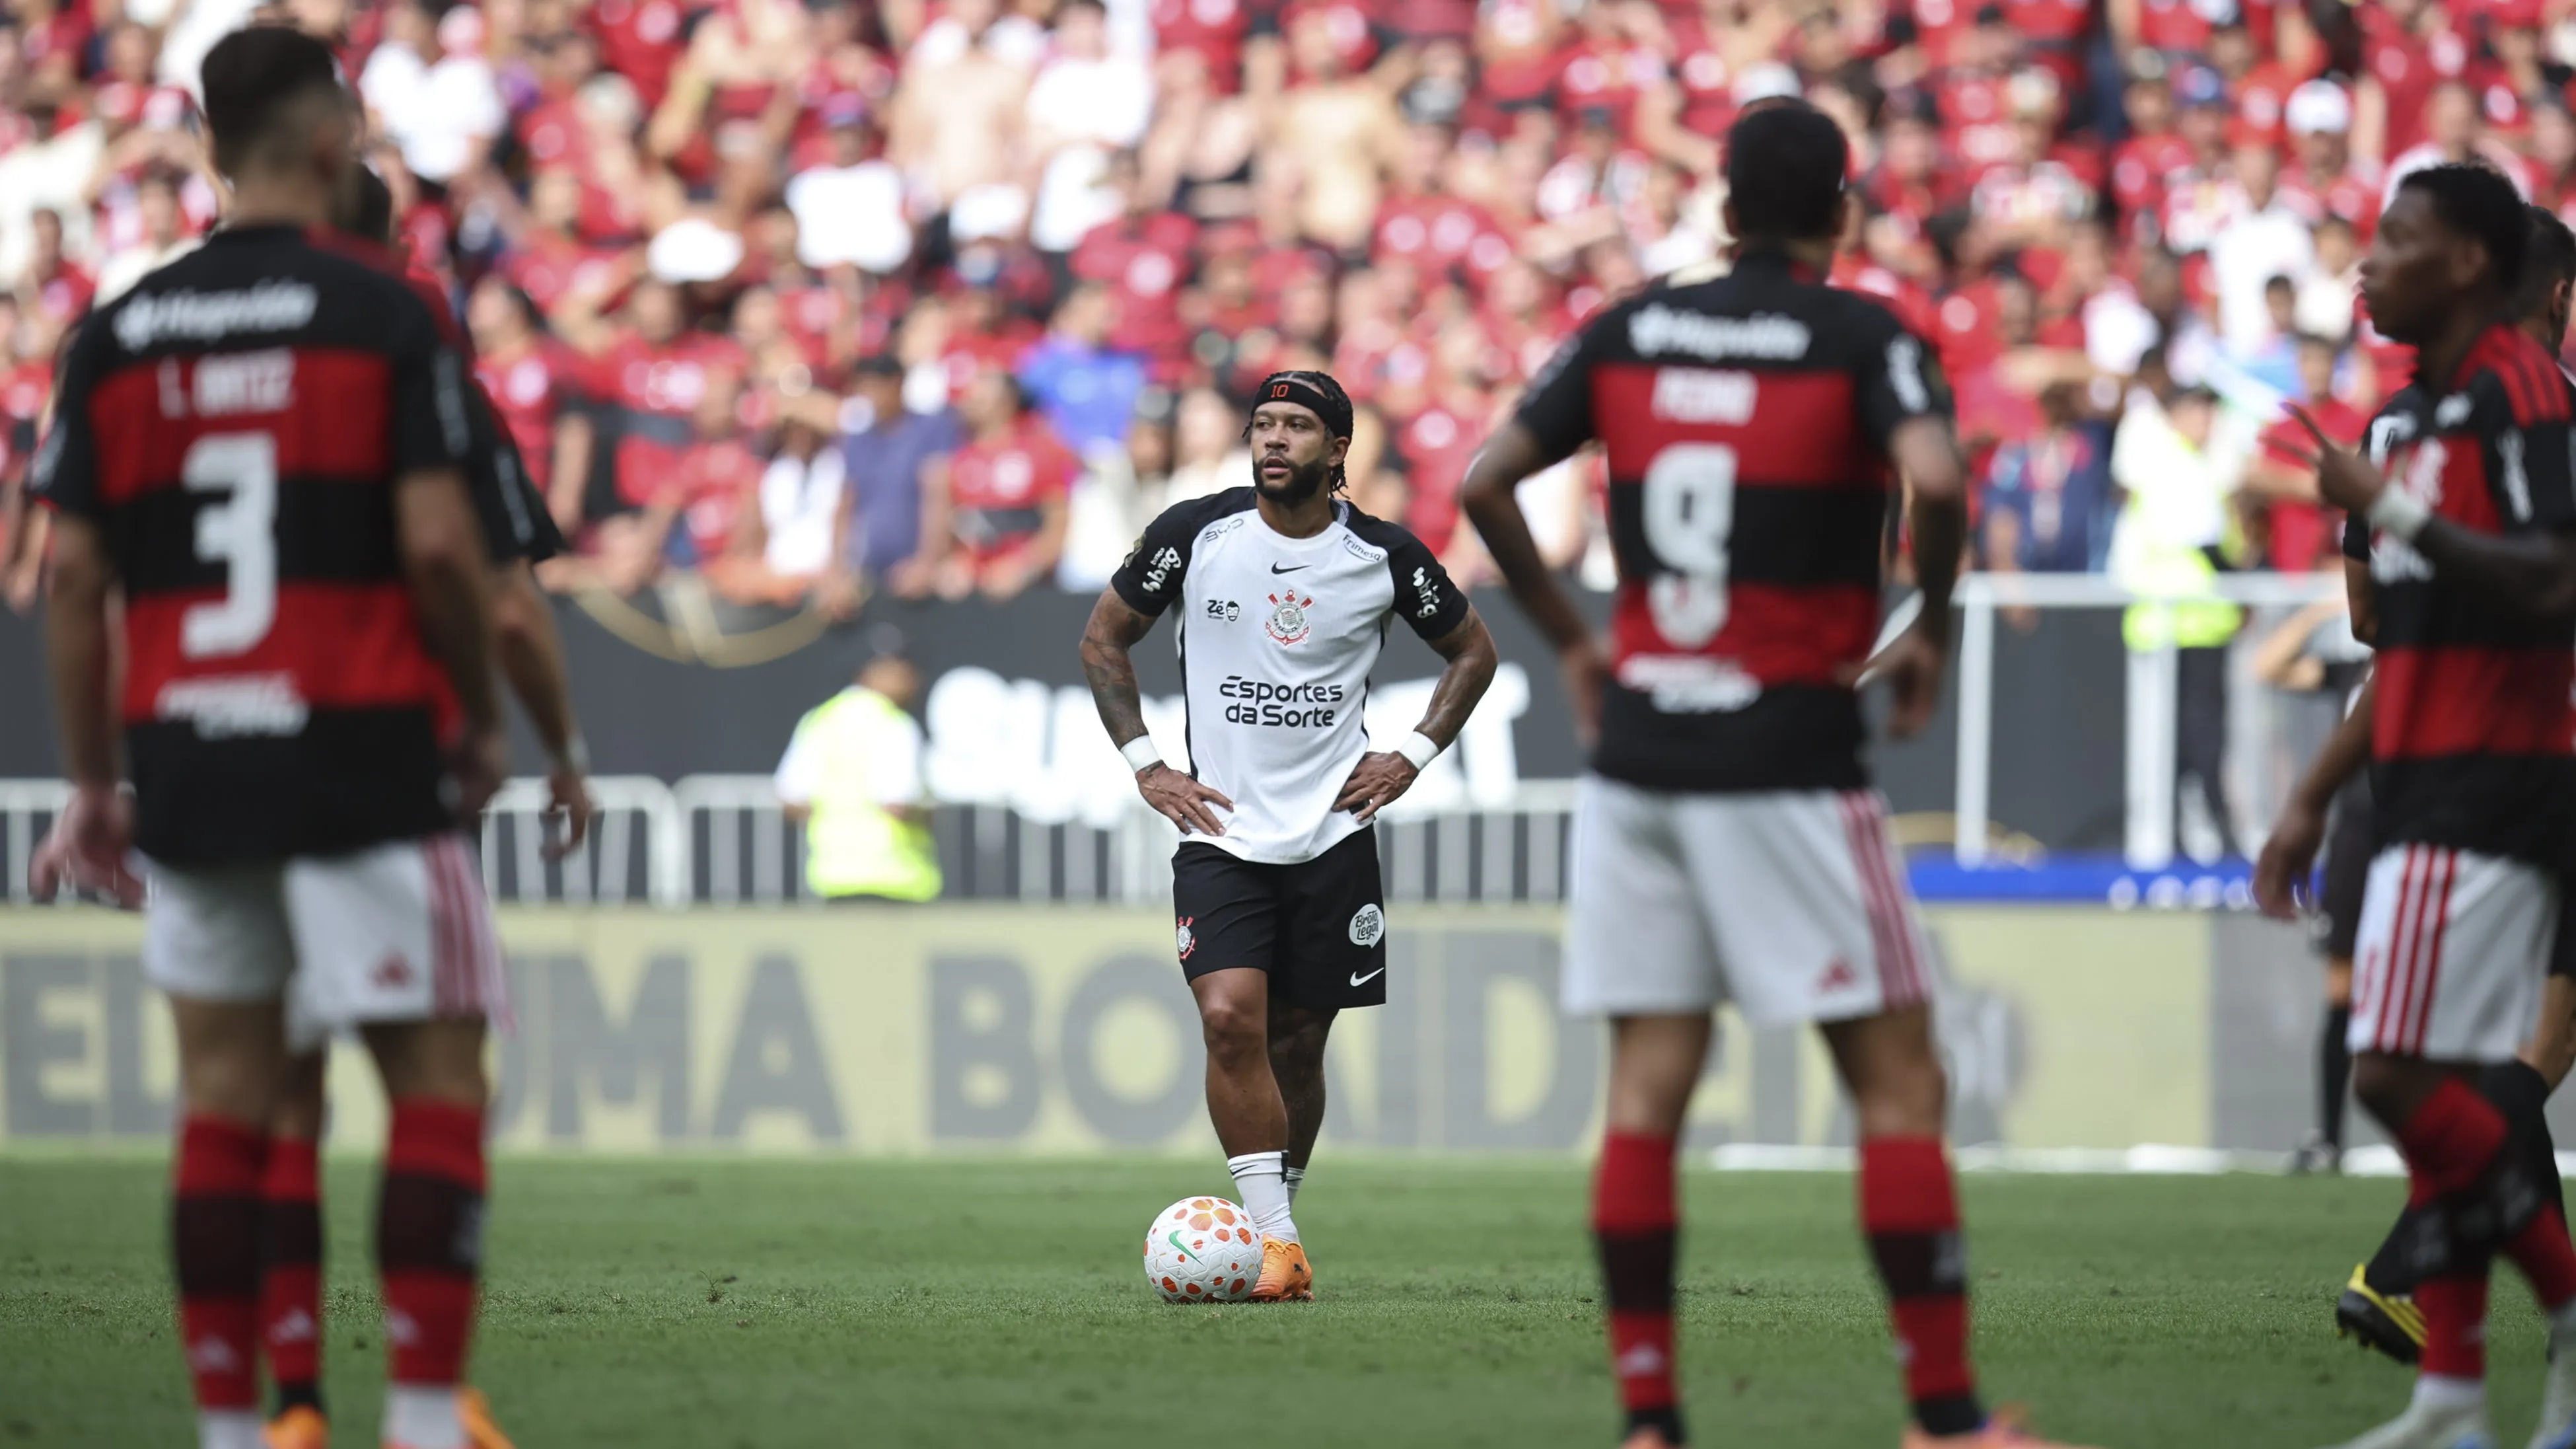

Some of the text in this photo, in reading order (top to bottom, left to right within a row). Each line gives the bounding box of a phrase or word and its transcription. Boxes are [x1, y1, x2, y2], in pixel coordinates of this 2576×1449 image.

[1271, 384, 1289, 398] 10
[180, 432, 277, 659] 3
[1343, 534, 1381, 561] Frimesa
[1643, 441, 1739, 650] 9
[1207, 599, 1225, 615] Zé
[1219, 675, 1343, 706] Esportes
[1225, 702, 1334, 727] da Sorte
